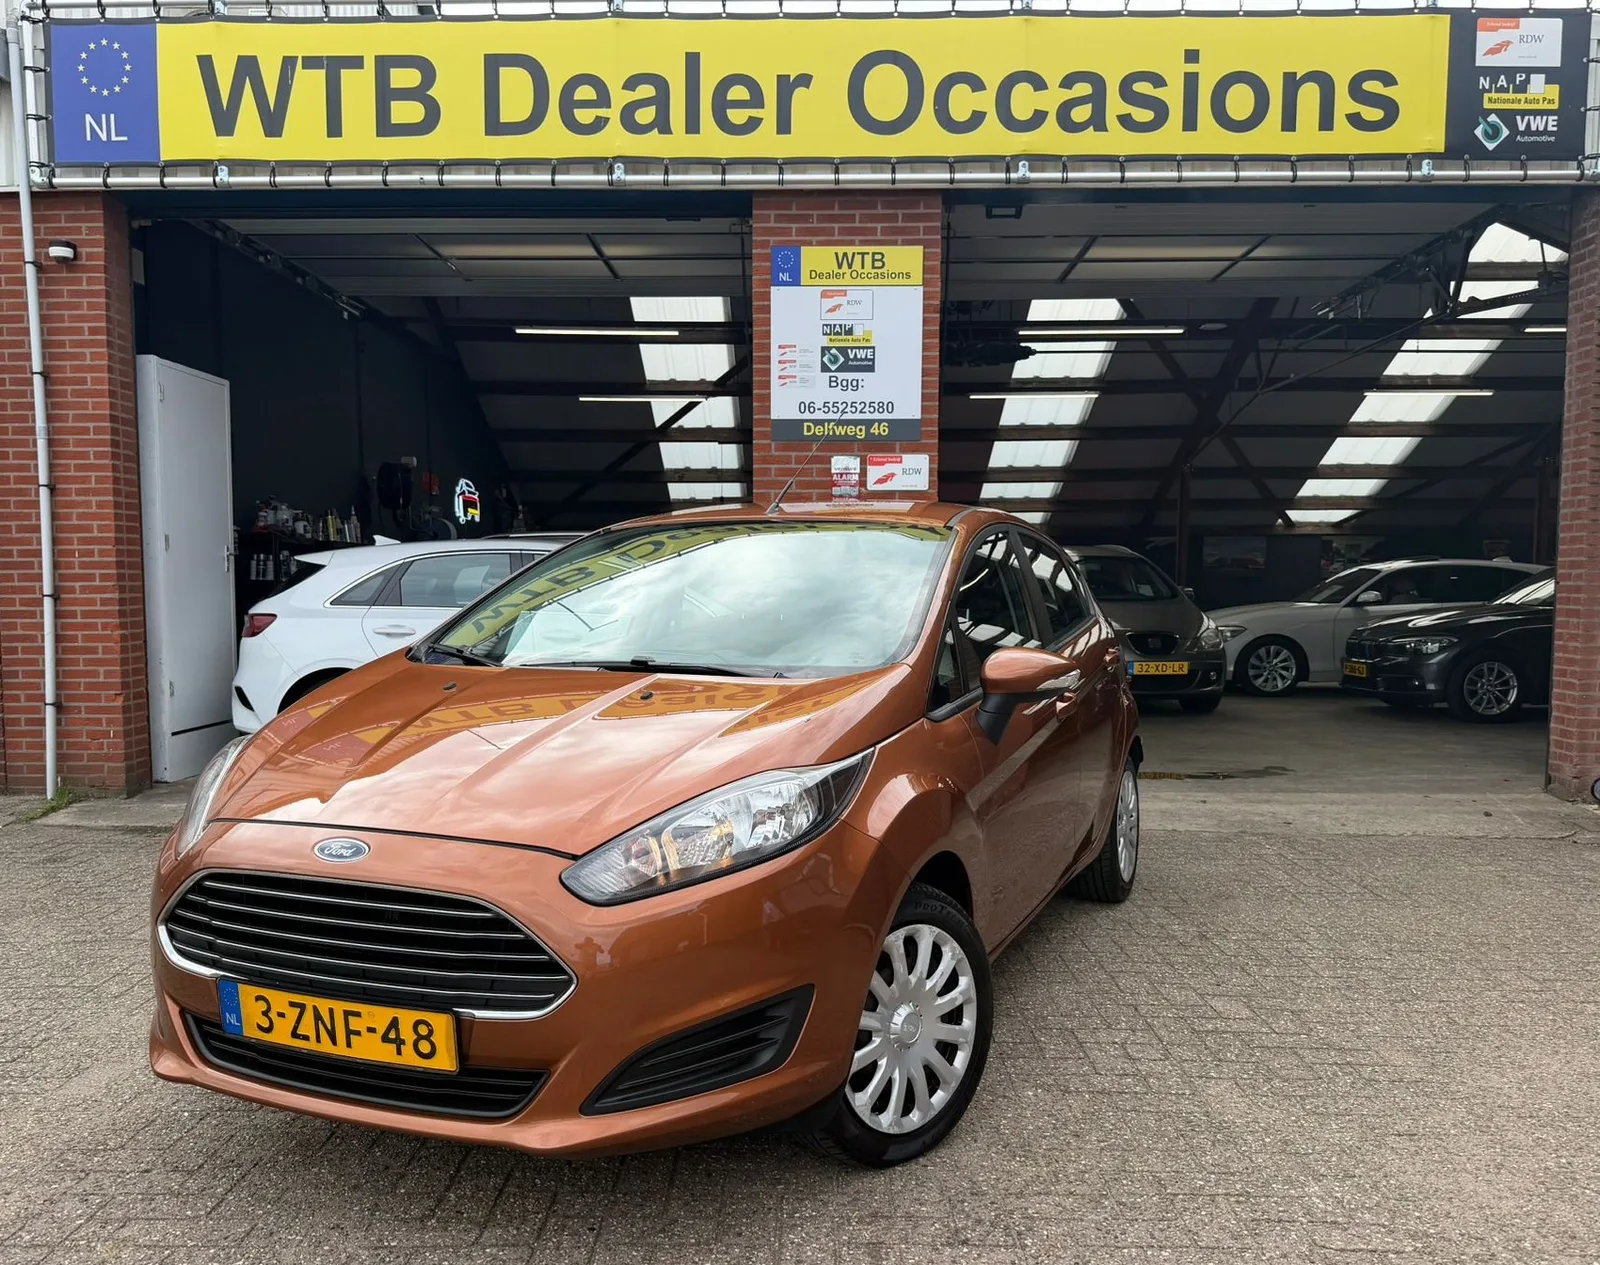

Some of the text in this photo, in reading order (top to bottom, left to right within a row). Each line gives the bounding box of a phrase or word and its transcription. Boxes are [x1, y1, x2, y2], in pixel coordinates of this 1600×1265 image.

[1518, 34, 1545, 44] RDW
[196, 49, 1400, 138] WTB Dealer Occasions
[1487, 96, 1556, 105] Nationale Auto Pas
[85, 113, 128, 142] NL
[1515, 115, 1559, 131] VWE
[1516, 135, 1556, 143] Automotive
[834, 252, 886, 270] WTB
[778, 272, 793, 282] NL
[809, 269, 912, 280] Dealer Occasions
[823, 323, 852, 335] NAP
[847, 348, 874, 359] VWE
[828, 375, 865, 392] Bgg:
[798, 401, 894, 415] 06-55252580
[803, 422, 889, 440] Delfweg 46
[901, 467, 922, 476] RDW
[324, 840, 358, 857] Ford
[226, 994, 438, 1061] NL 3-ZNF-48
